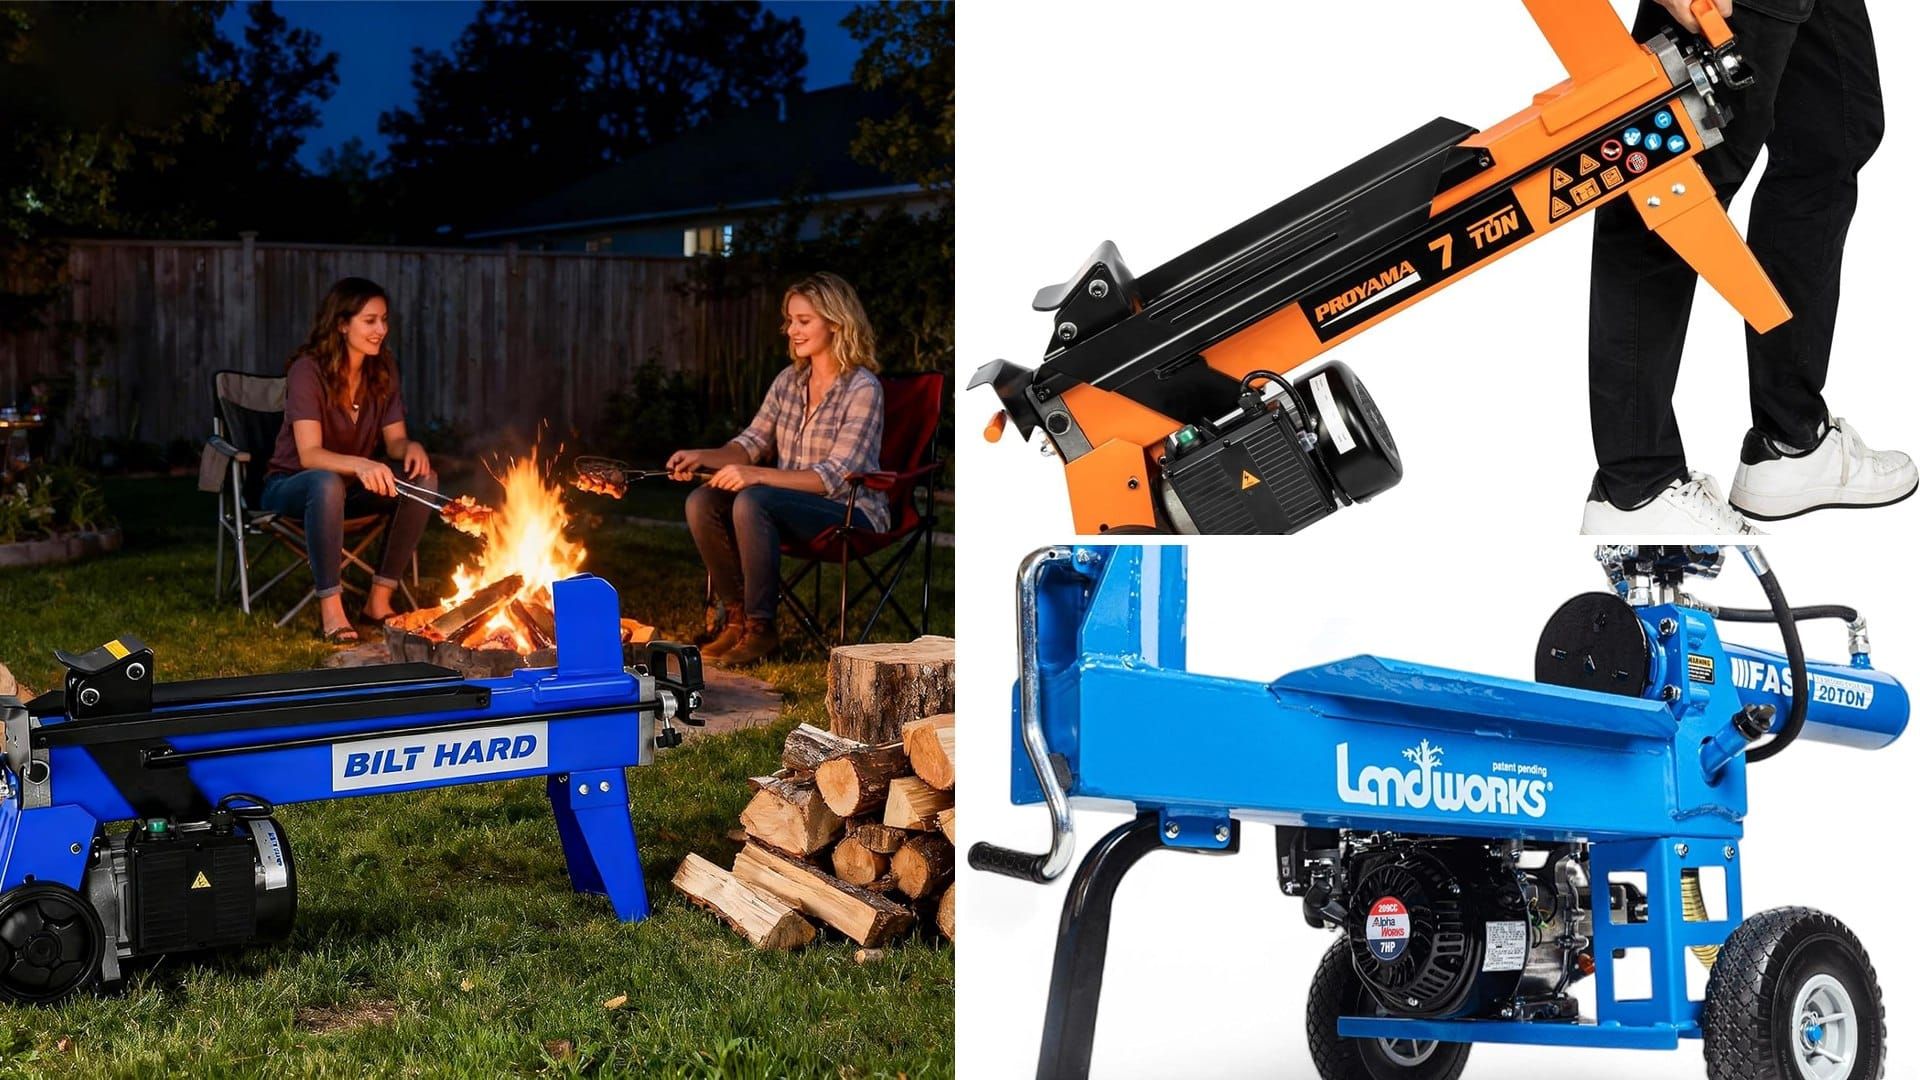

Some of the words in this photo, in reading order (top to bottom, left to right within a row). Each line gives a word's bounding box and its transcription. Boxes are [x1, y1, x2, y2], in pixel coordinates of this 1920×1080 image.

[1314, 260, 1416, 322] PROYAMA
[1428, 233, 1453, 270] 7
[1467, 204, 1519, 249] TON
[344, 746, 425, 778] BILT
[433, 734, 538, 768] HARD
[1492, 761, 1517, 773] patent
[1518, 763, 1548, 778] pending
[1378, 904, 1398, 913] 209CC
[1372, 916, 1396, 928] Alpha
[1380, 941, 1396, 953] 7HP
